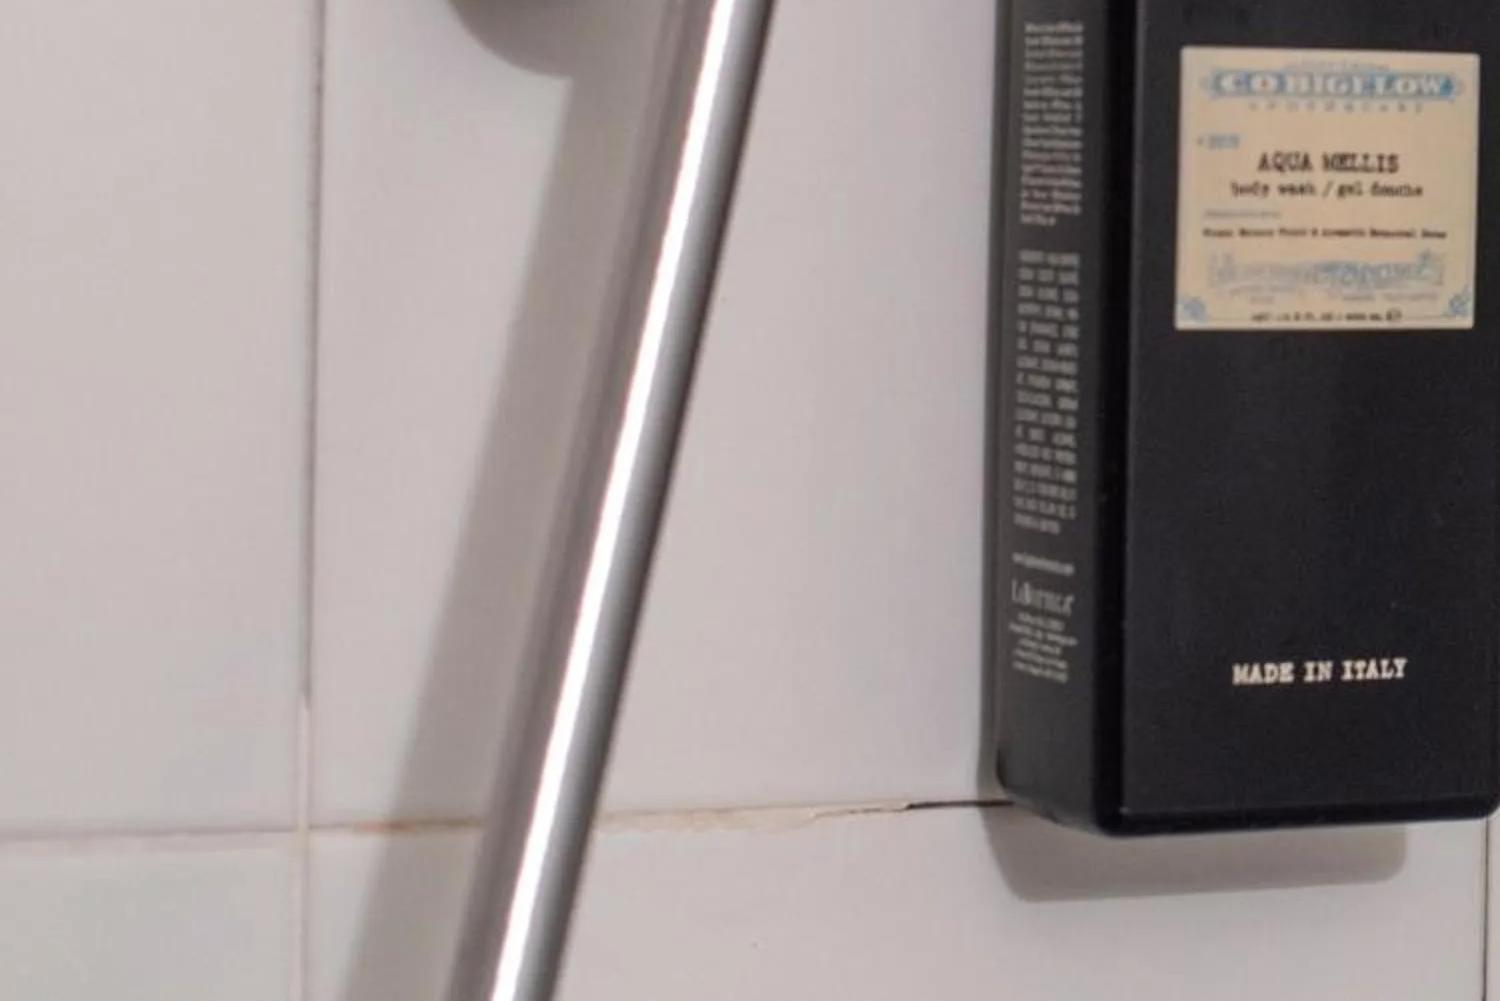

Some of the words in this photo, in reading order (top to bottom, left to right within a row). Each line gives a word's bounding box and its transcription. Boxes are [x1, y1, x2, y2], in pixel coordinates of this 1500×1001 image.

[1257, 151, 1313, 174] AQUA
[1322, 152, 1400, 174] MELLIS
[1232, 662, 1294, 685] MADE
[1304, 660, 1333, 683] IN
[1341, 657, 1408, 681] ITALY
